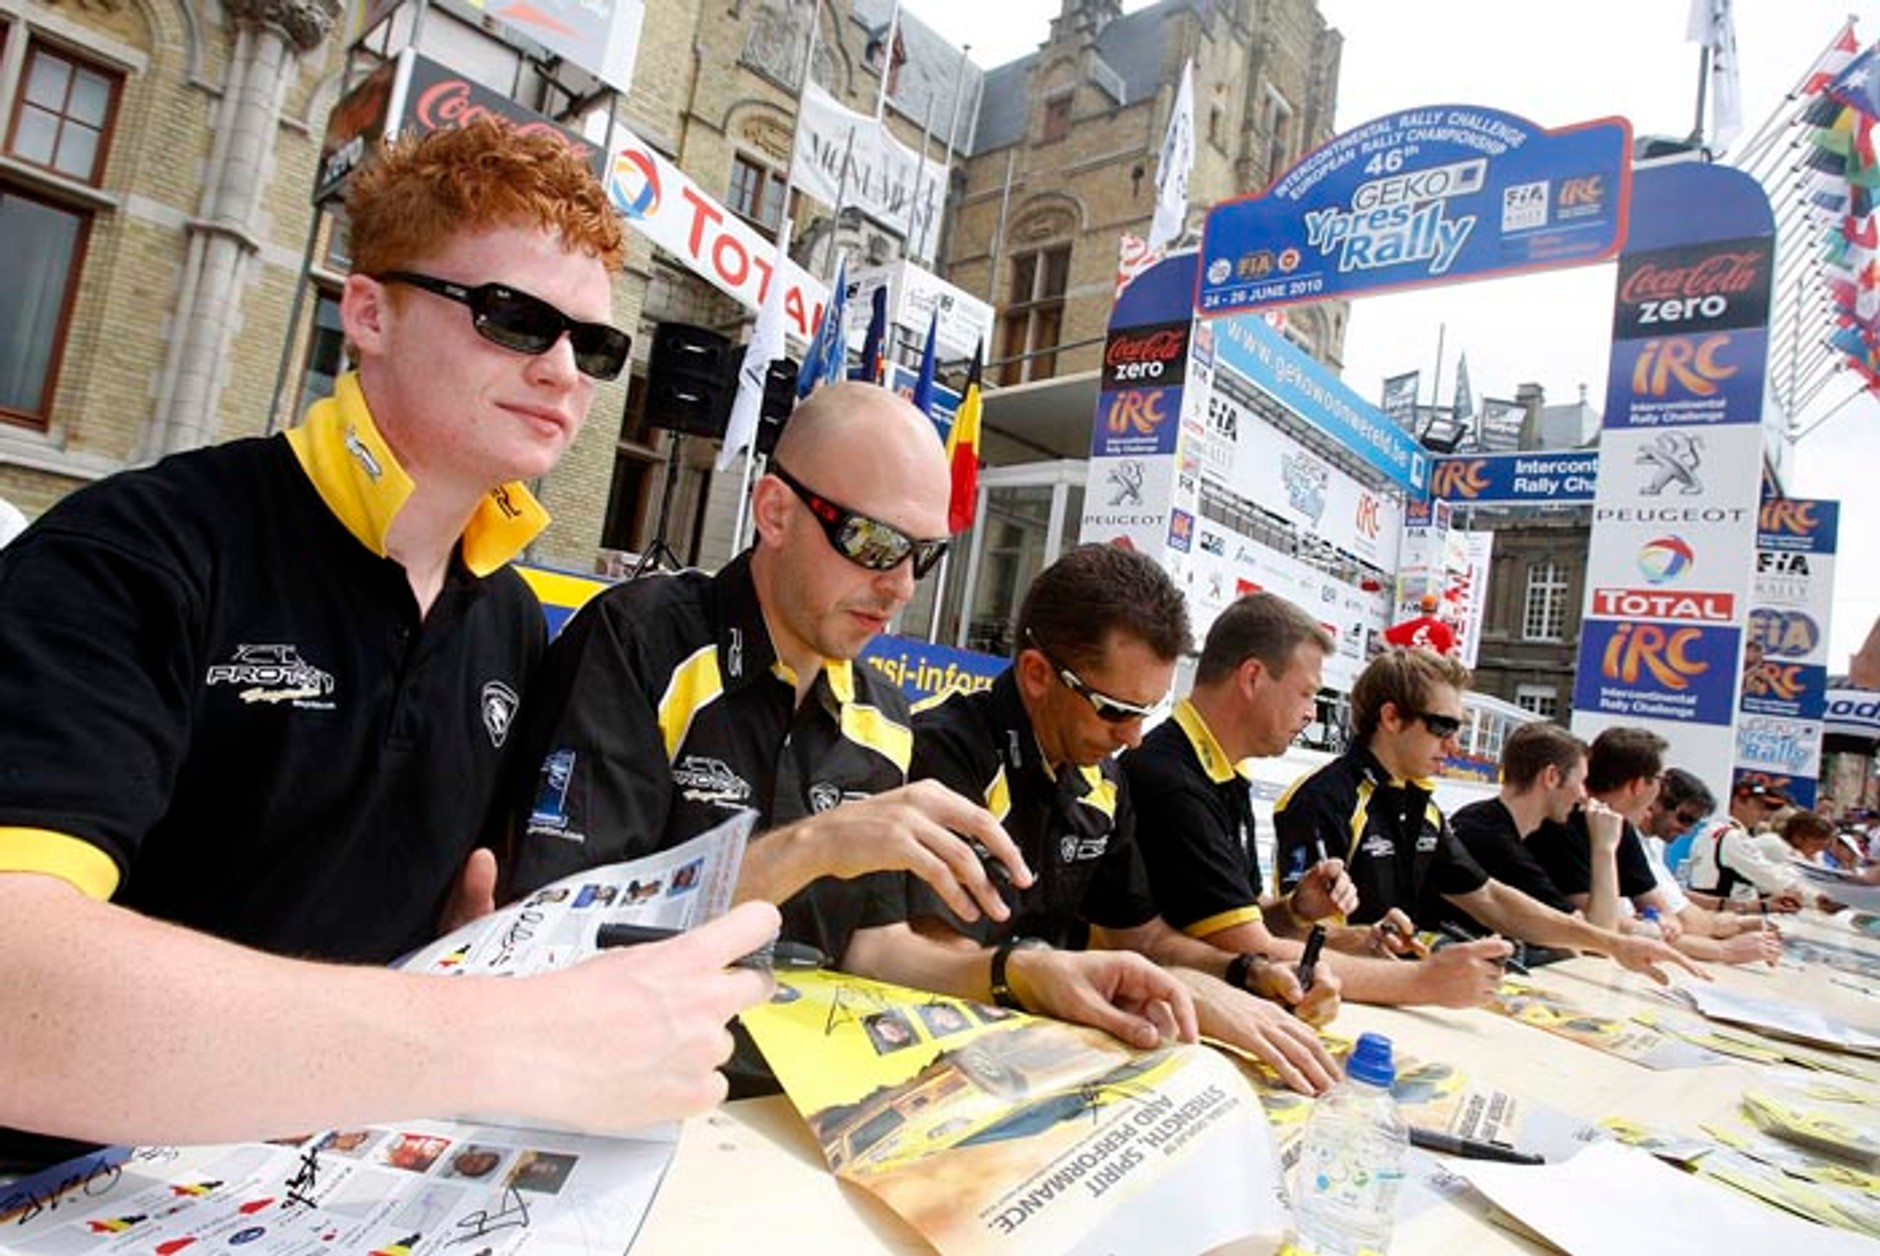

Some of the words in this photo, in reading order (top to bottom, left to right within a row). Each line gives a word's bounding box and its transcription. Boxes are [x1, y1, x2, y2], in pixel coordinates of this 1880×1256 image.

[1399, 111, 1443, 128] RALLY
[1447, 112, 1528, 149] CHALLENGE
[1289, 147, 1356, 201] EUROPEAN
[1361, 130, 1404, 153] RALLY
[1406, 127, 1508, 155] CHAMPIONSHIP
[1363, 144, 1419, 175] 46th
[1356, 170, 1449, 210] GEKO
[1305, 203, 1411, 255] Ypres
[1338, 199, 1478, 273] Rally
[1248, 284, 1286, 301] JUNE
[1289, 278, 1323, 296] 2010
[1621, 252, 1763, 302] Coca-Cola
[1638, 294, 1728, 324] zero
[1106, 329, 1185, 366] Coca-Cola
[1114, 360, 1164, 380] zero
[1514, 478, 1559, 495] Rally
[1085, 515, 1166, 526] PEUGEOT
[1598, 508, 1747, 523] PEUGEOT
[1598, 591, 1729, 619] TOTAL
[1600, 698, 1630, 712] Rally
[1632, 700, 1695, 717] Challenge
[1132, 1094, 1175, 1128] AND
[1137, 1083, 1227, 1150] STRENGTH,
[987, 1120, 1139, 1235] PERFORMANCE.
[1084, 1145, 1144, 1199] SPIRIT
